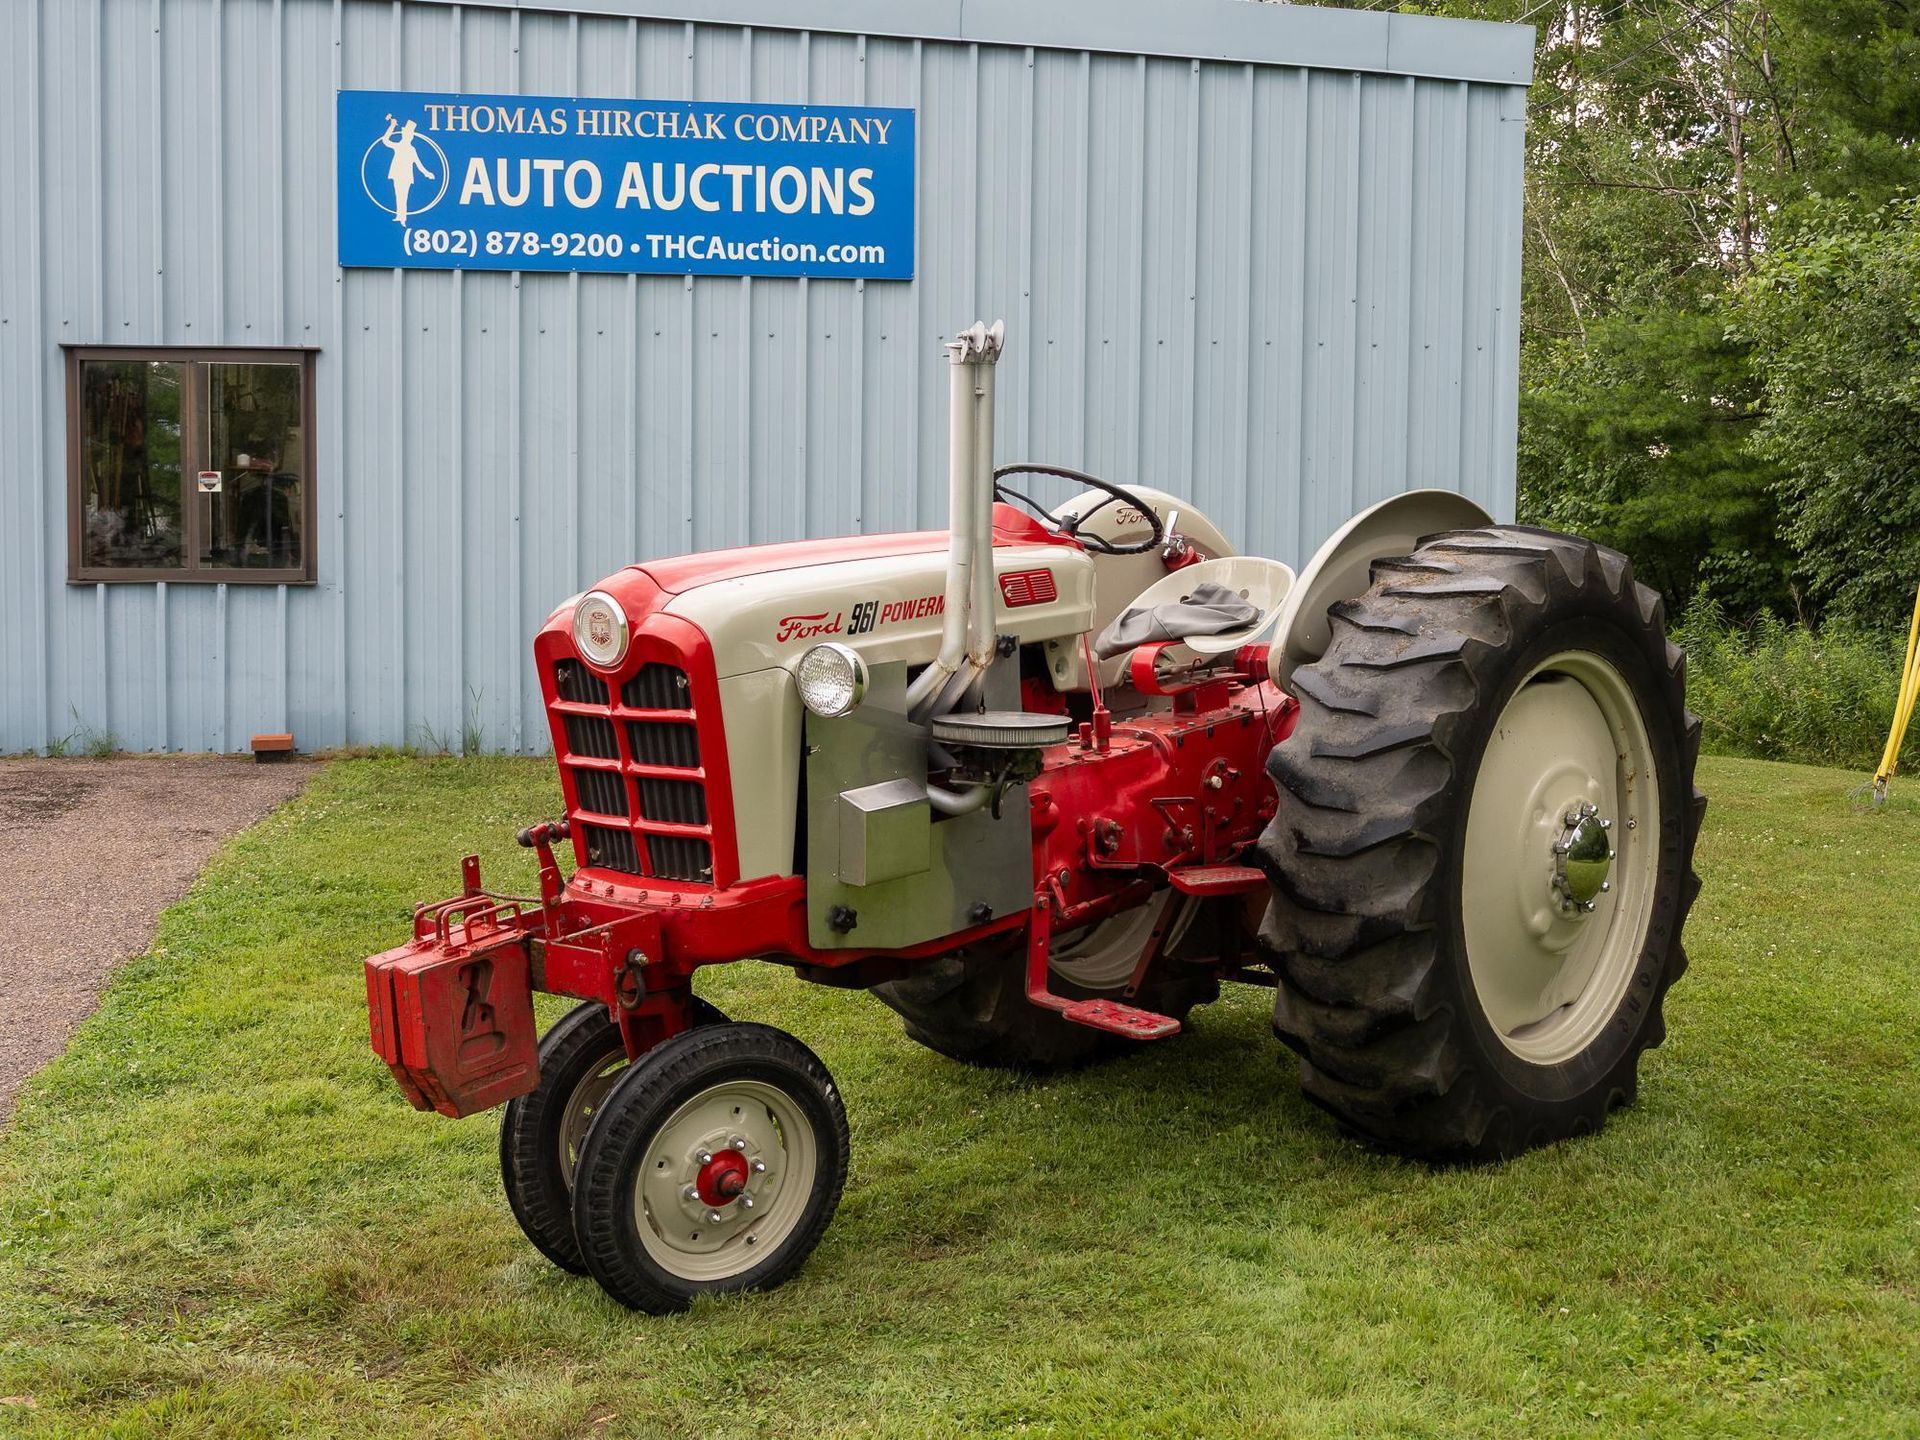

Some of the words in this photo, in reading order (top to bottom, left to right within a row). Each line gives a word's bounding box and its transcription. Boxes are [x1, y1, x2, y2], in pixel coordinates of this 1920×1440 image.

[424, 104, 567, 136] THOMAS
[575, 109, 727, 140] HIRCHAK
[734, 114, 892, 145] COMPANY
[459, 157, 603, 209] AUTO
[615, 161, 875, 216] AUCTIONS
[403, 228, 478, 258] (802)
[485, 230, 623, 258] 878-9200
[645, 234, 885, 264] THCAuction.com
[776, 611, 843, 643] Ford
[846, 600, 880, 636] 961
[879, 594, 947, 625] POWERM
